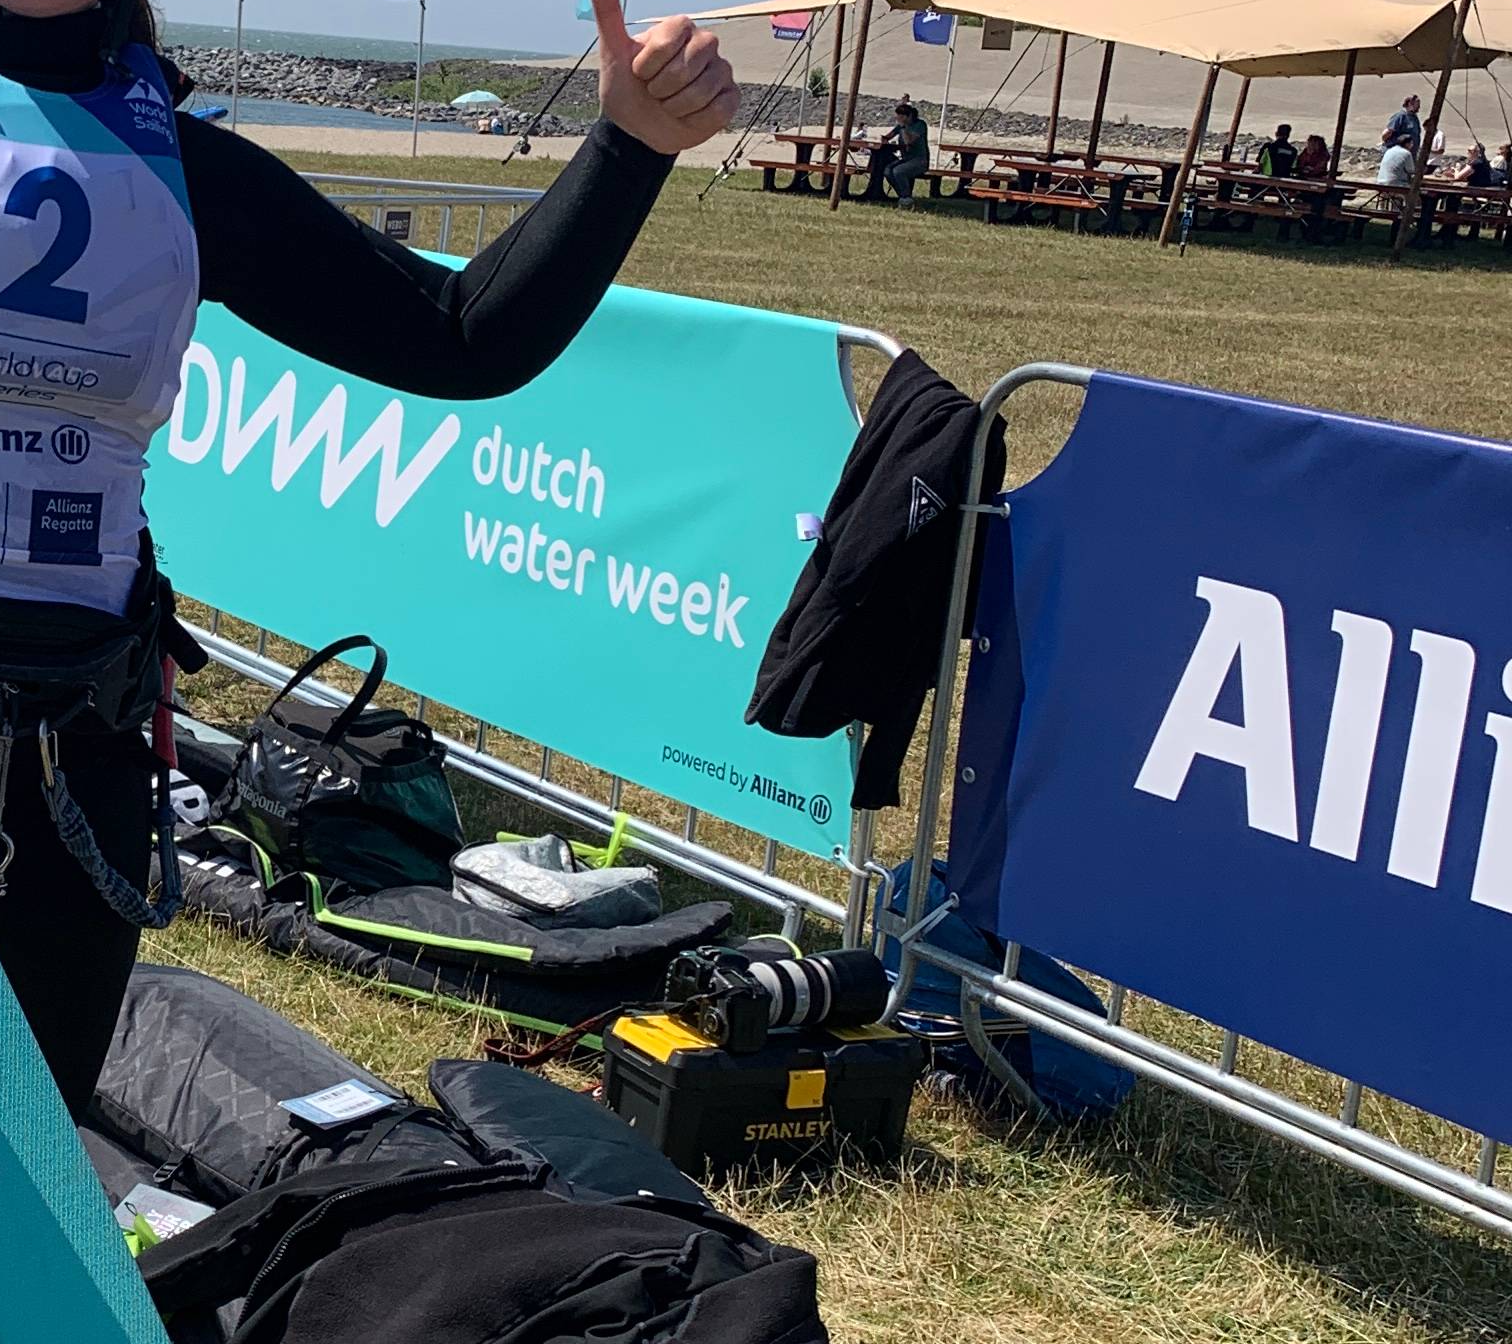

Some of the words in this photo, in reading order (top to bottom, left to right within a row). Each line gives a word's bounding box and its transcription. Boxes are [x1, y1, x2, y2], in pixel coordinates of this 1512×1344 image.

[128, 102, 169, 123] World
[42, 360, 99, 392] Cup
[471, 424, 606, 518] dutch
[45, 498, 92, 515] Allianz
[41, 516, 94, 534] Regatta
[464, 511, 596, 596] water
[606, 555, 750, 649] week
[662, 744, 727, 781] powered
[729, 764, 749, 793] by
[750, 773, 807, 813] Allianz
[743, 1120, 832, 1142] STANLEY
[144, 1208, 165, 1229] LY
